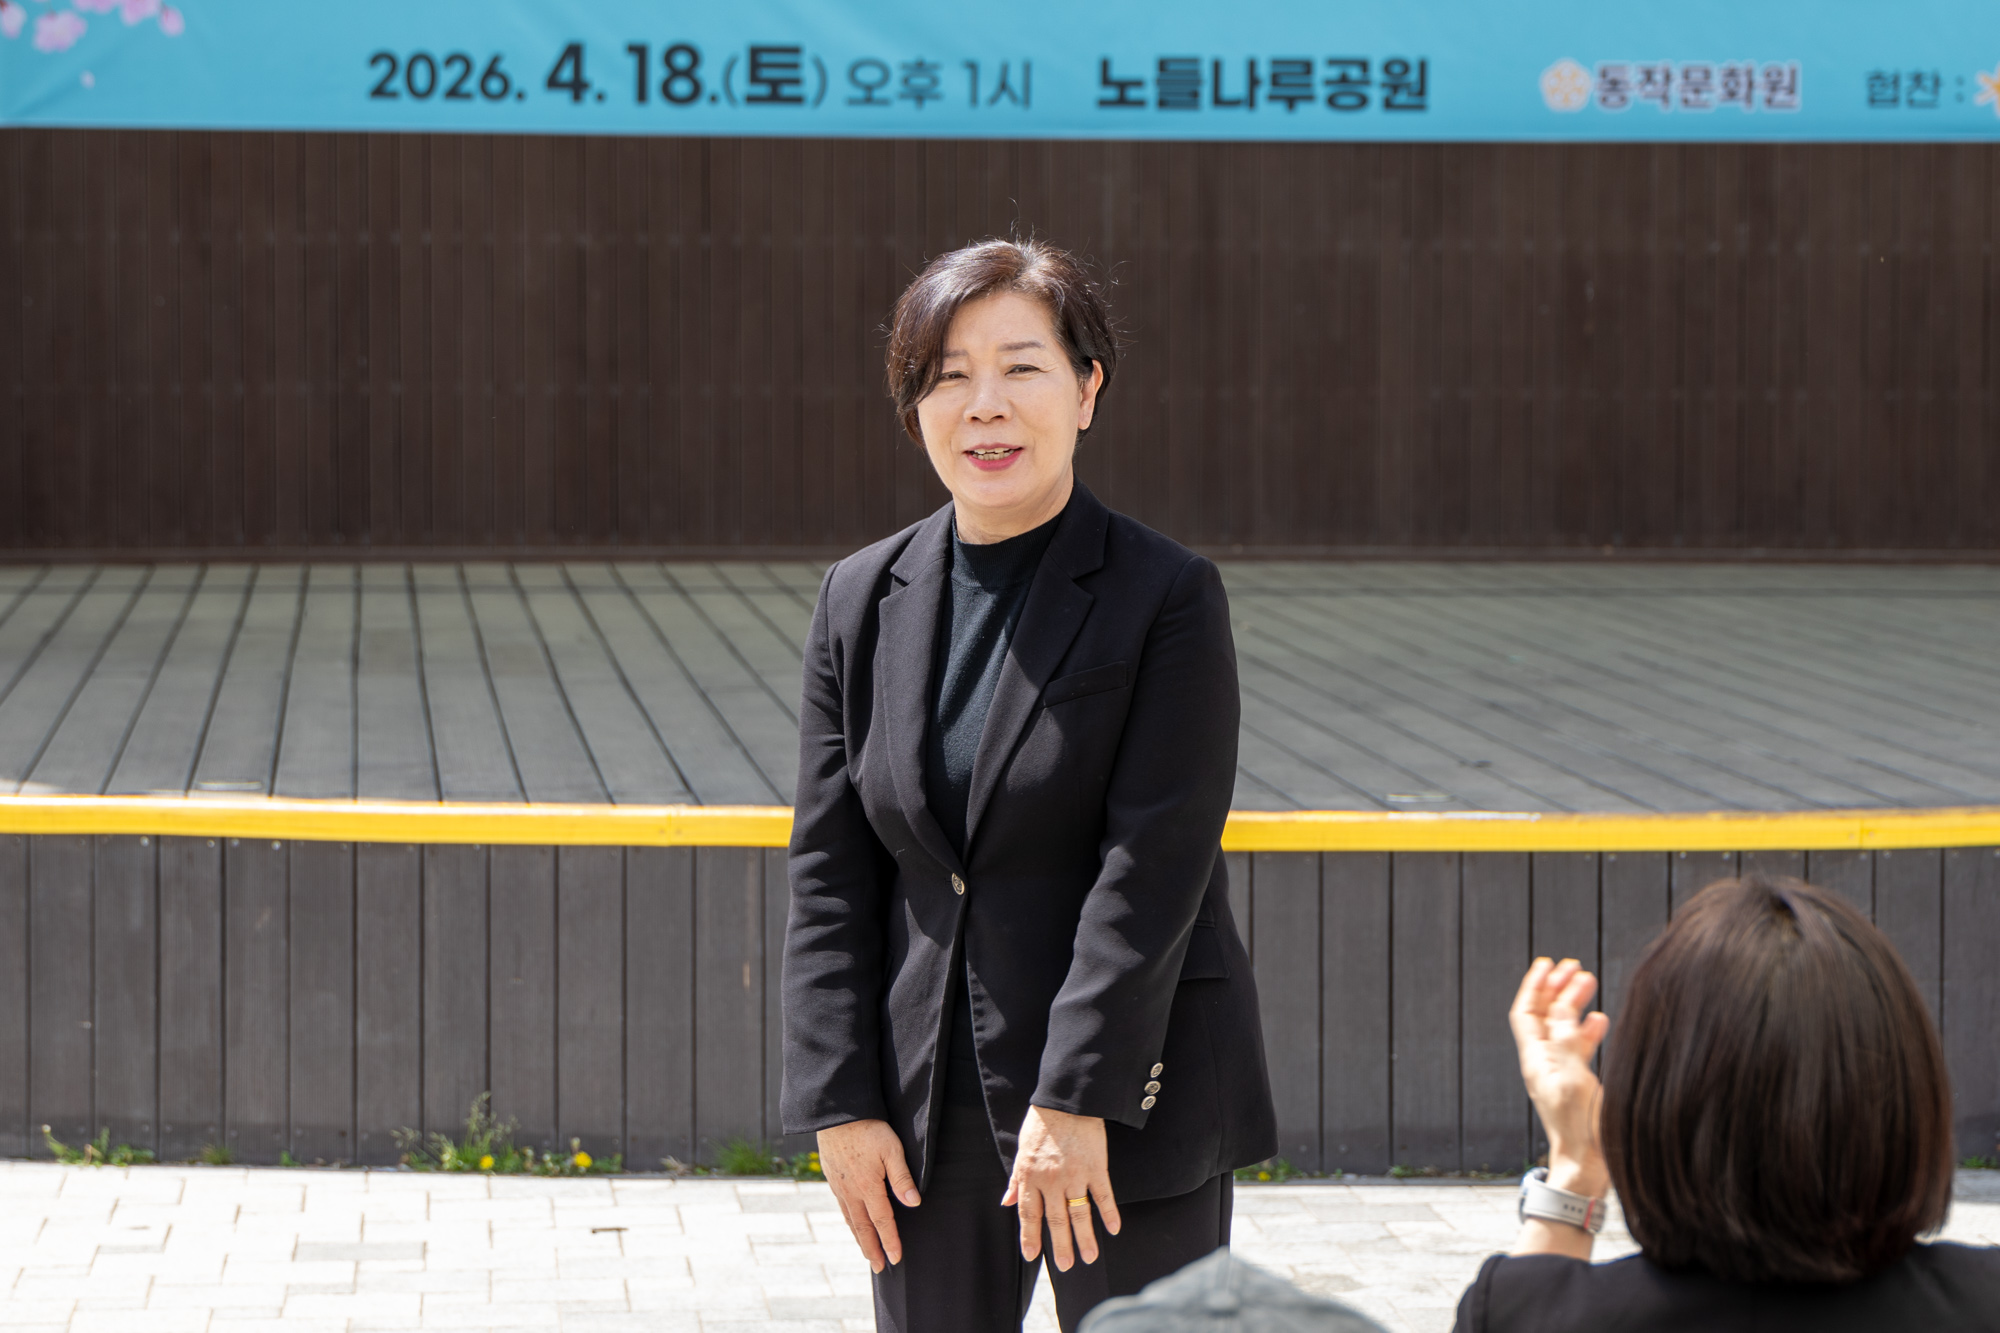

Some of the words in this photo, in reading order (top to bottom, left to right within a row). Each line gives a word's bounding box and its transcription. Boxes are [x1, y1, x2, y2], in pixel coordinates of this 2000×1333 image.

[368, 51, 526, 101] 2026.
[544, 41, 606, 105] 4.
[846, 58, 942, 108] 오후
[963, 60, 1032, 110] 1시
[1096, 56, 1428, 112] 노들나루공원
[1597, 64, 1799, 109] 동작문화원
[1867, 70, 1941, 108] 협찬
